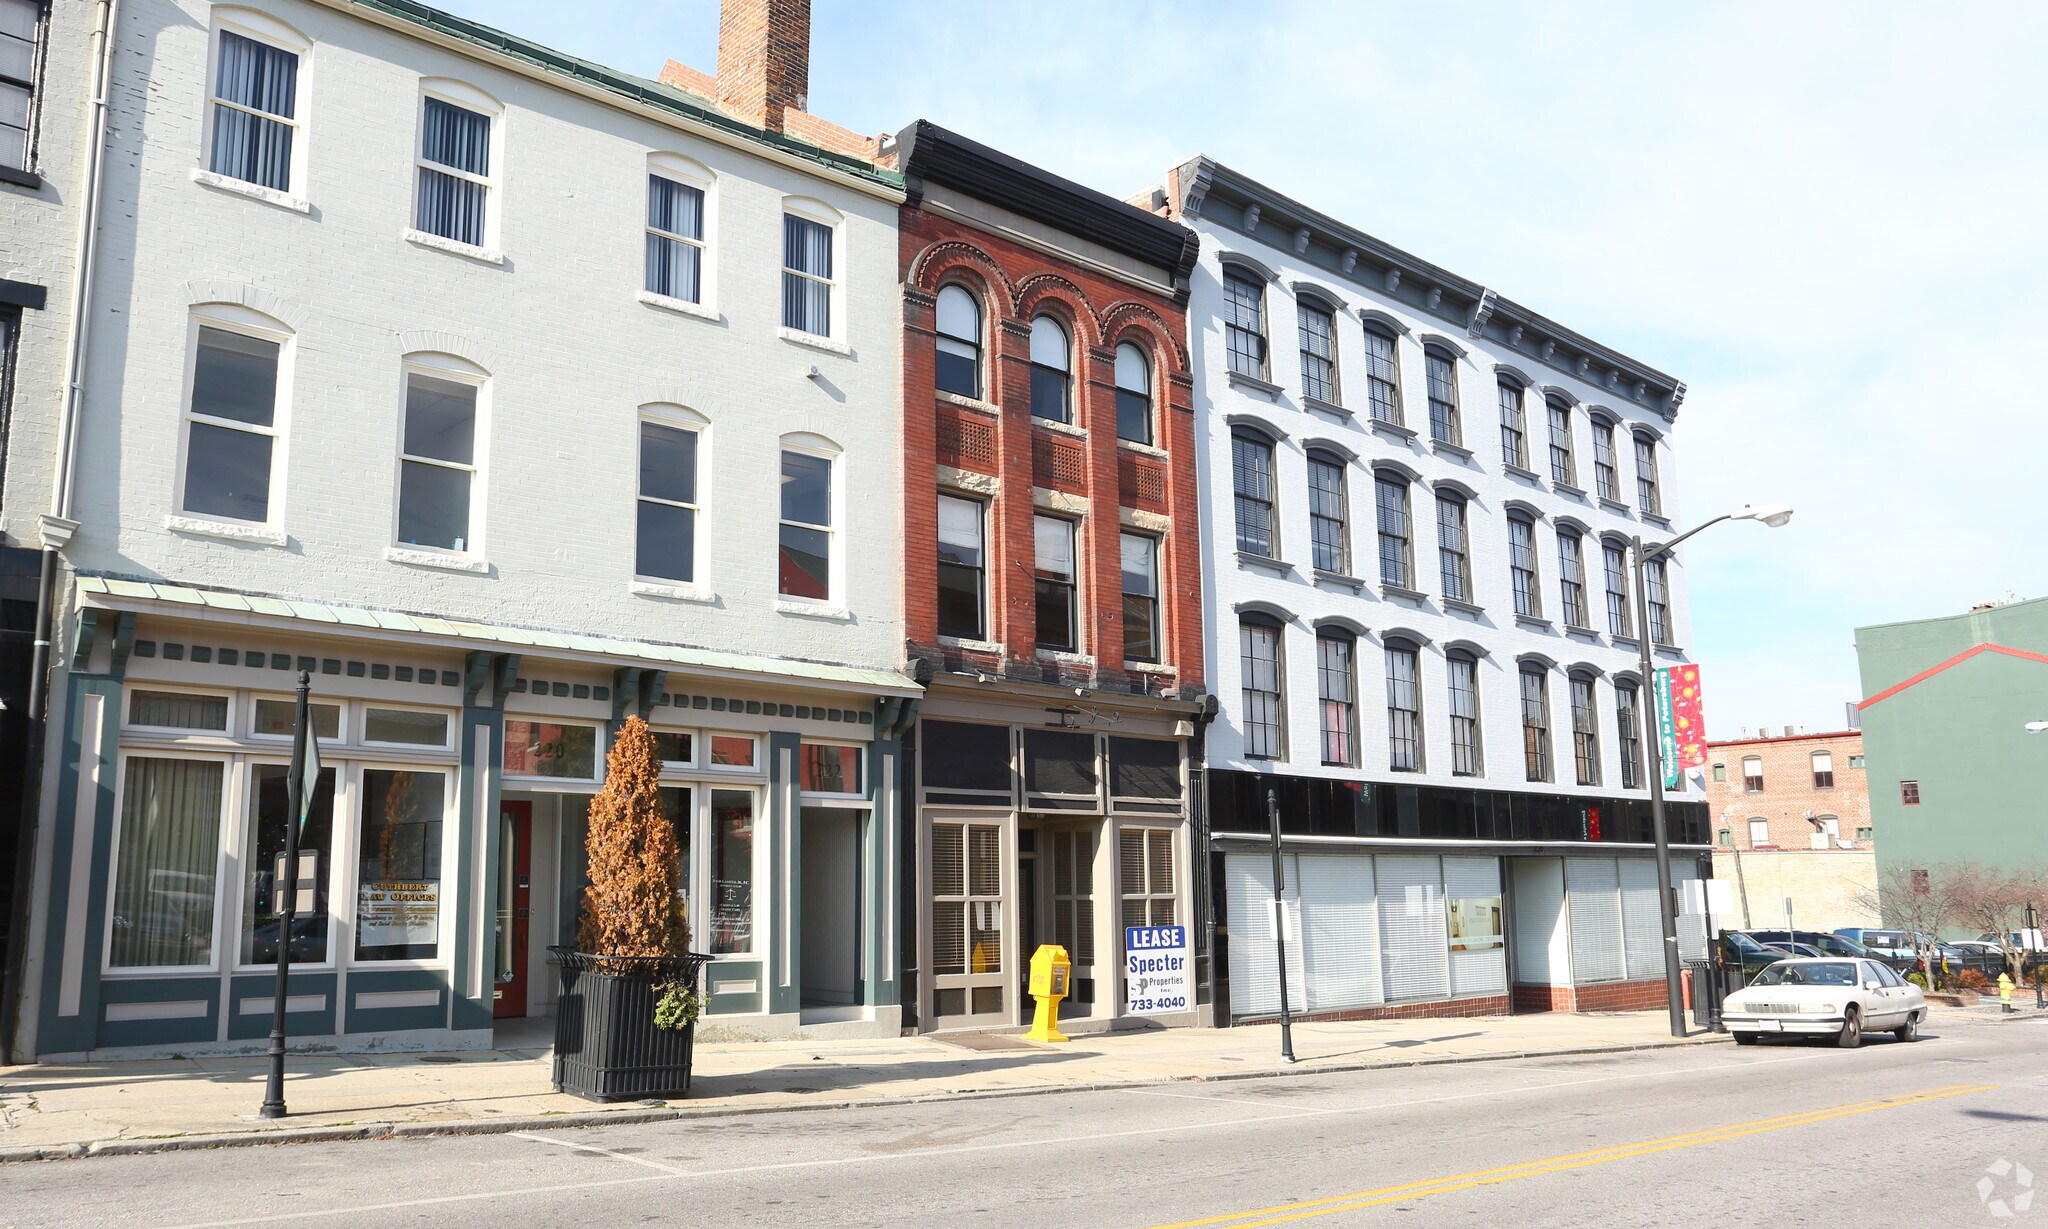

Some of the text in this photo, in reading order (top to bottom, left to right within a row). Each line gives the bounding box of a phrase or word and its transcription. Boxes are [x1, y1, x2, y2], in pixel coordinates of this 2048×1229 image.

[1660, 671, 1674, 778] Welcome to Petersburg
[1132, 928, 1180, 948] LEASE
[1129, 954, 1184, 975] Specter
[1149, 976, 1183, 987] Properties
[1130, 996, 1185, 1011] 733-4040
